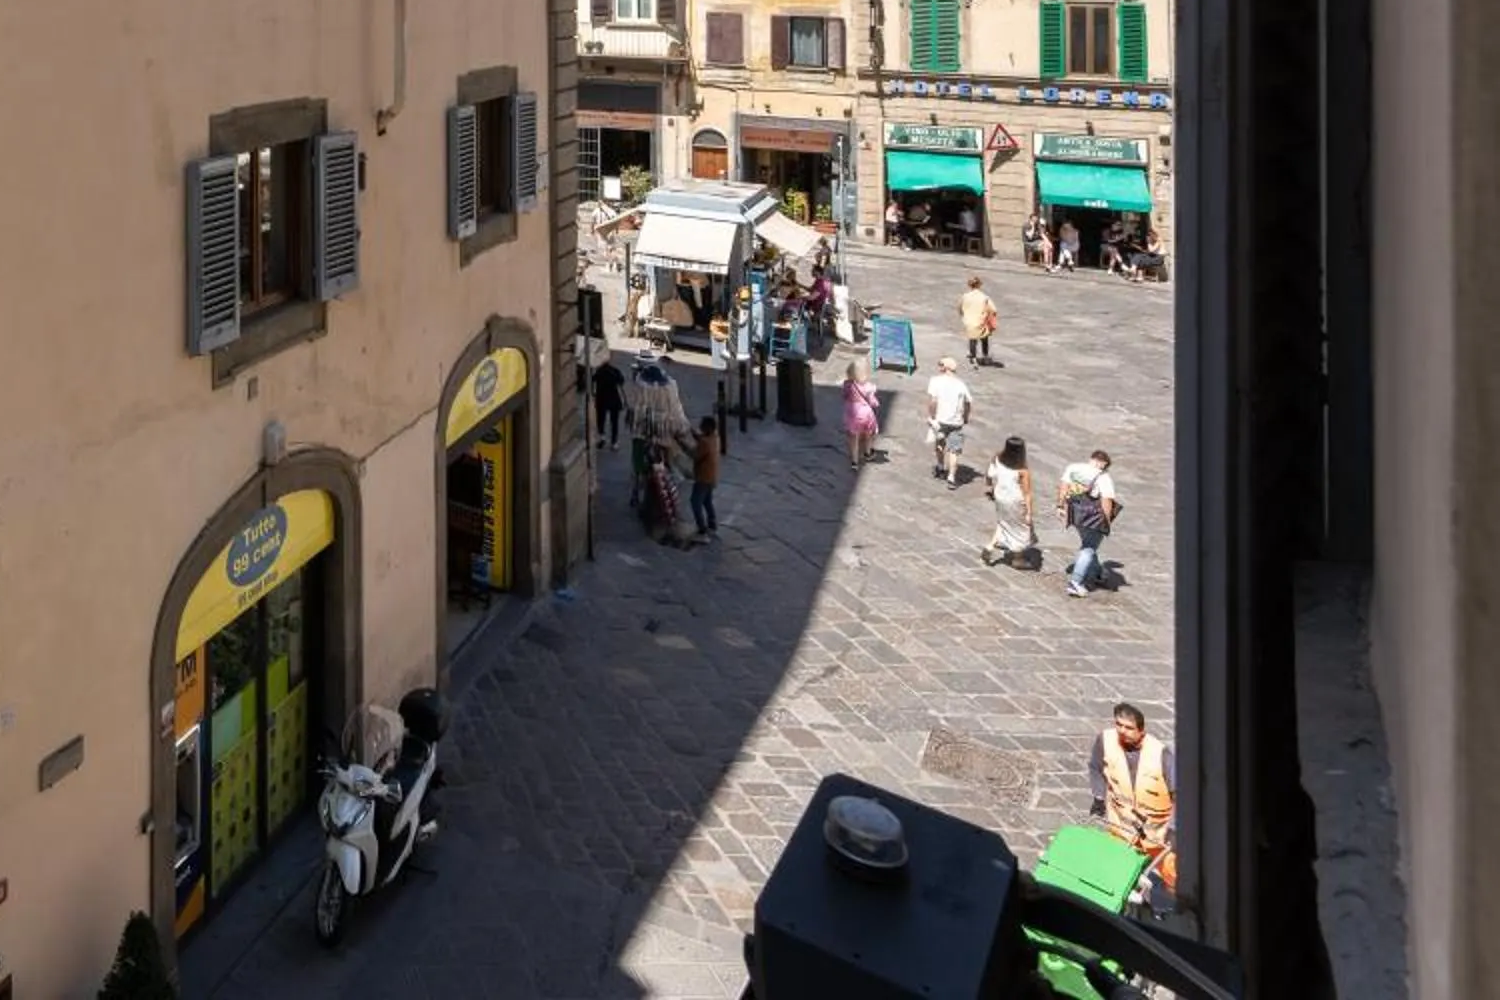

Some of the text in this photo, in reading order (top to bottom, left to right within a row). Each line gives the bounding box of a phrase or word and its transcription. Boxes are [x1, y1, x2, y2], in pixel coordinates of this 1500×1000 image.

[889, 79, 996, 99] HOTEL
[244, 514, 277, 547] Tutto
[233, 530, 281, 578] 99 cent
